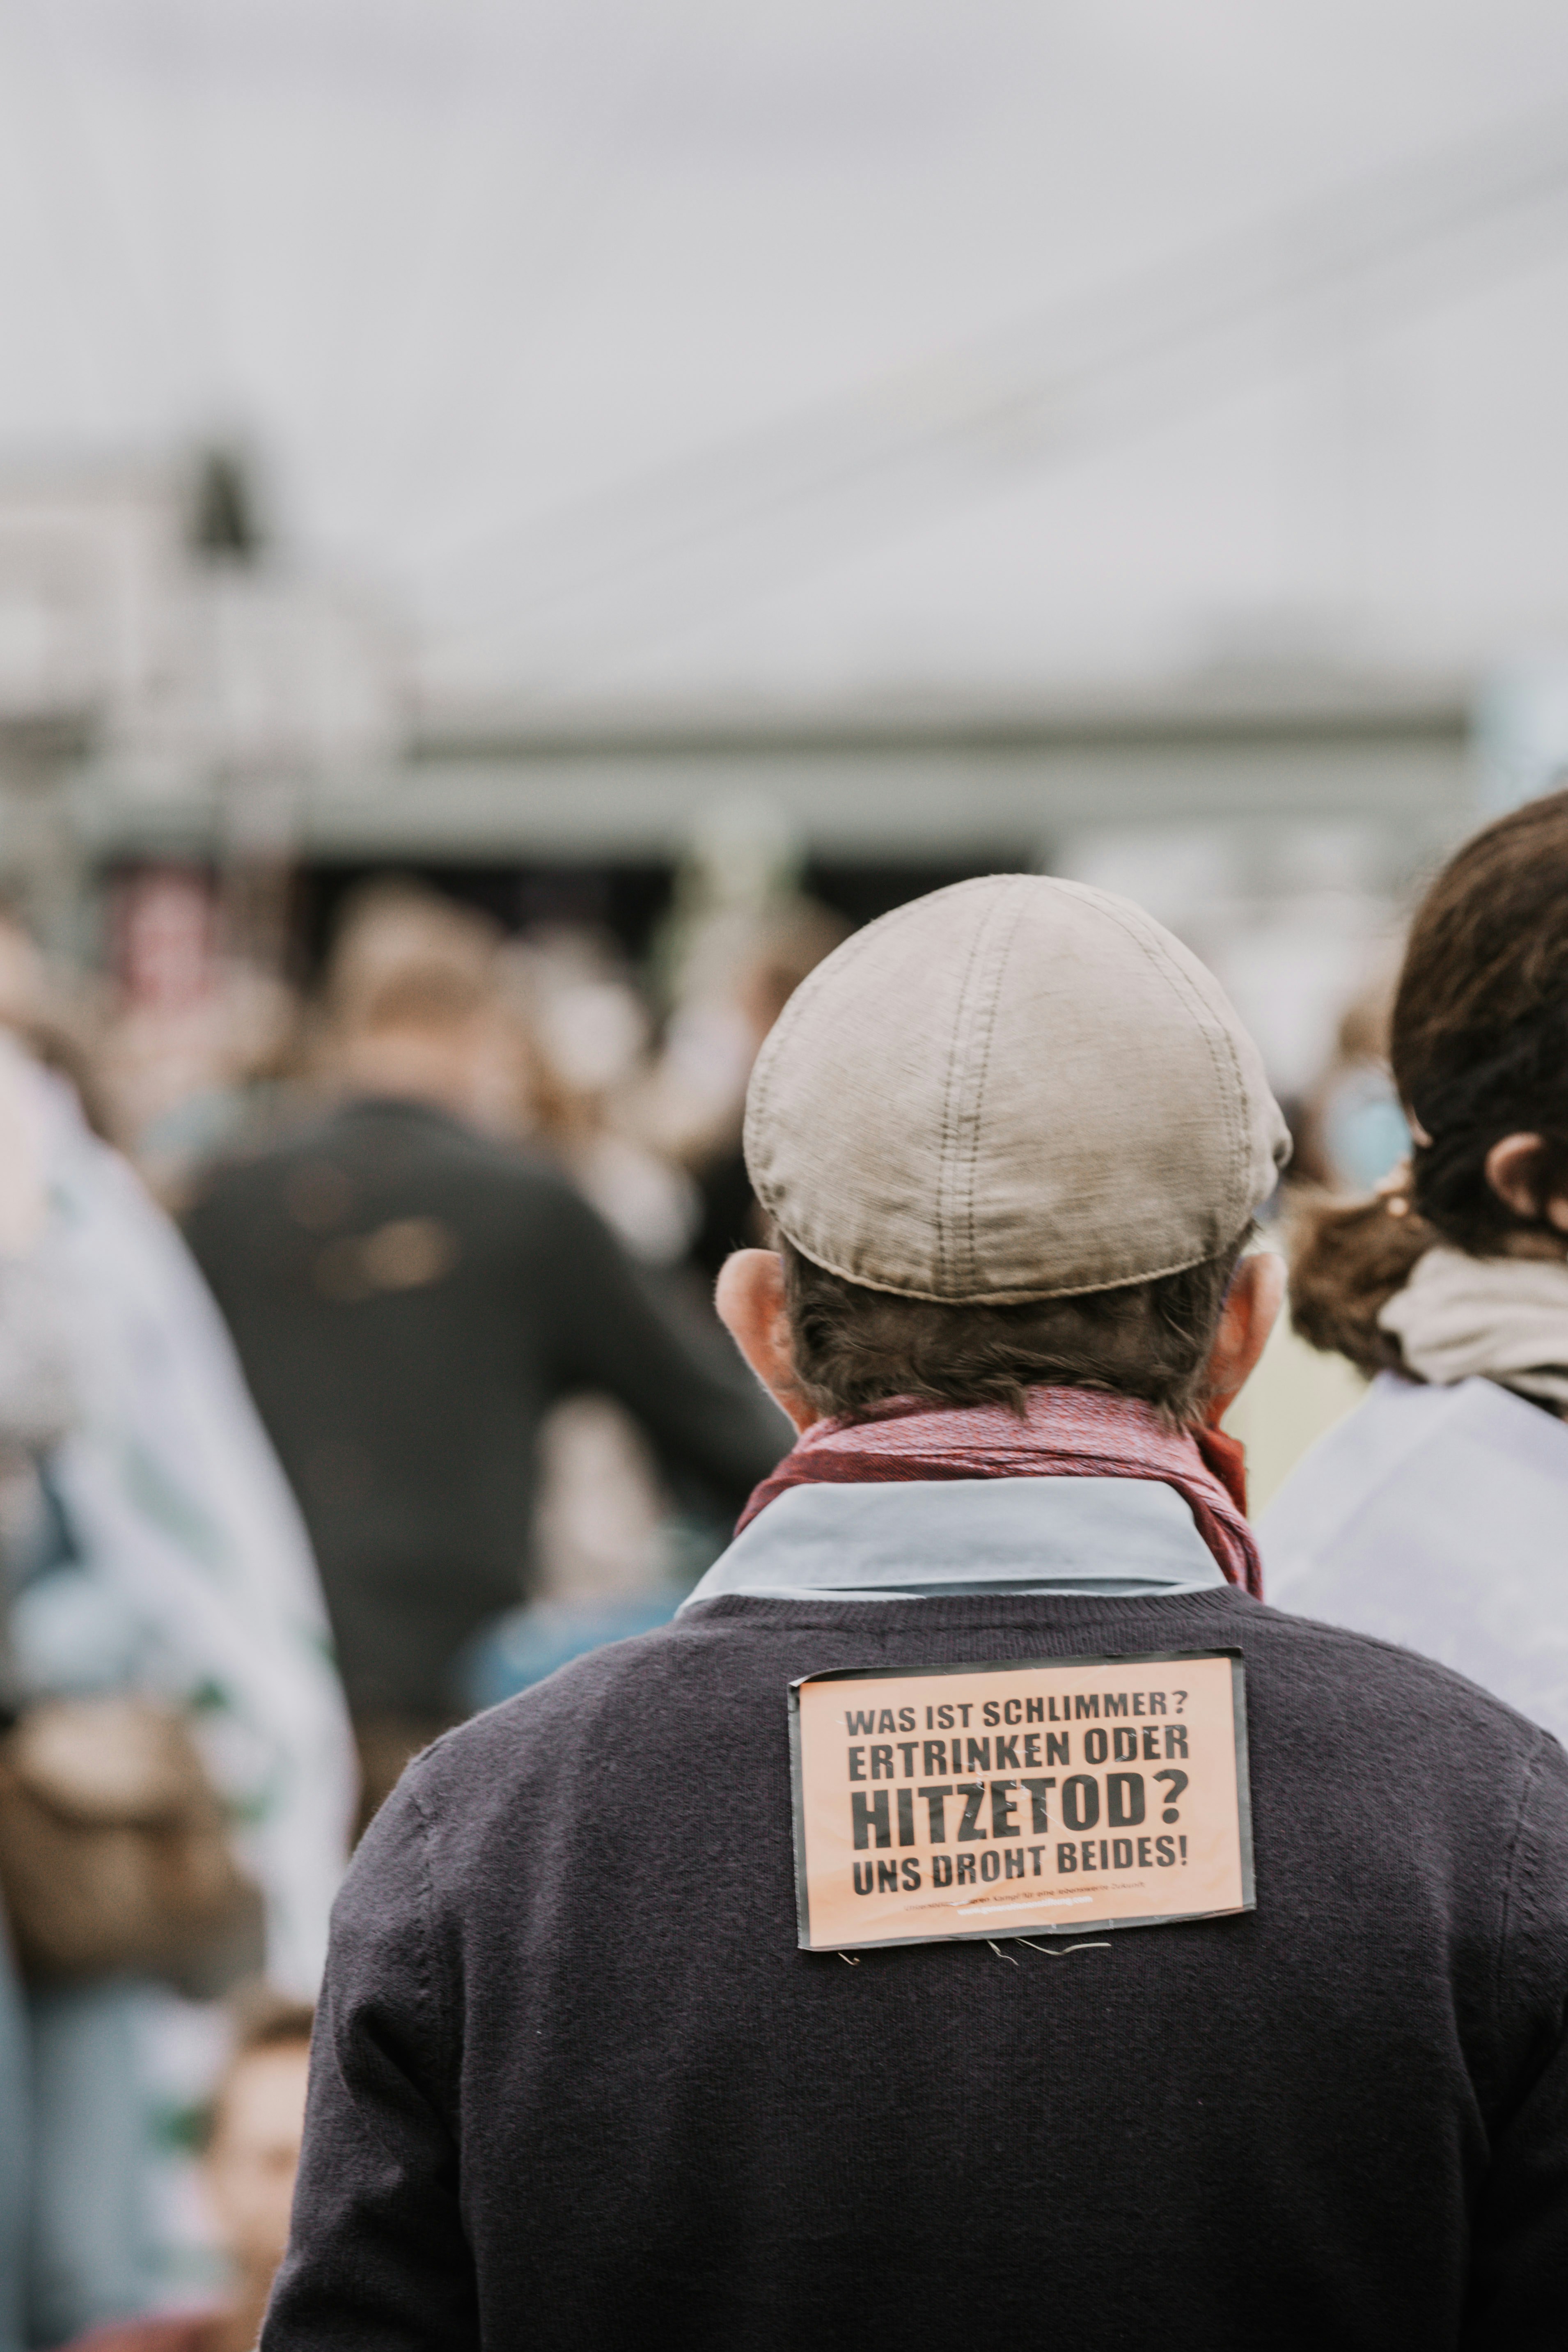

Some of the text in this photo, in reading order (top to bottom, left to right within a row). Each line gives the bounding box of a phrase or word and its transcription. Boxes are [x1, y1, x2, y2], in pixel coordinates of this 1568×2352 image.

[845, 1690, 1189, 1736] WAS IST SCHLIMMER?
[848, 1724, 1189, 1782] ERTRINKEN ODER
[850, 1768, 1190, 1851] HITZETOD?
[853, 1835, 1188, 1896] UNS DROHT BEIDES!
